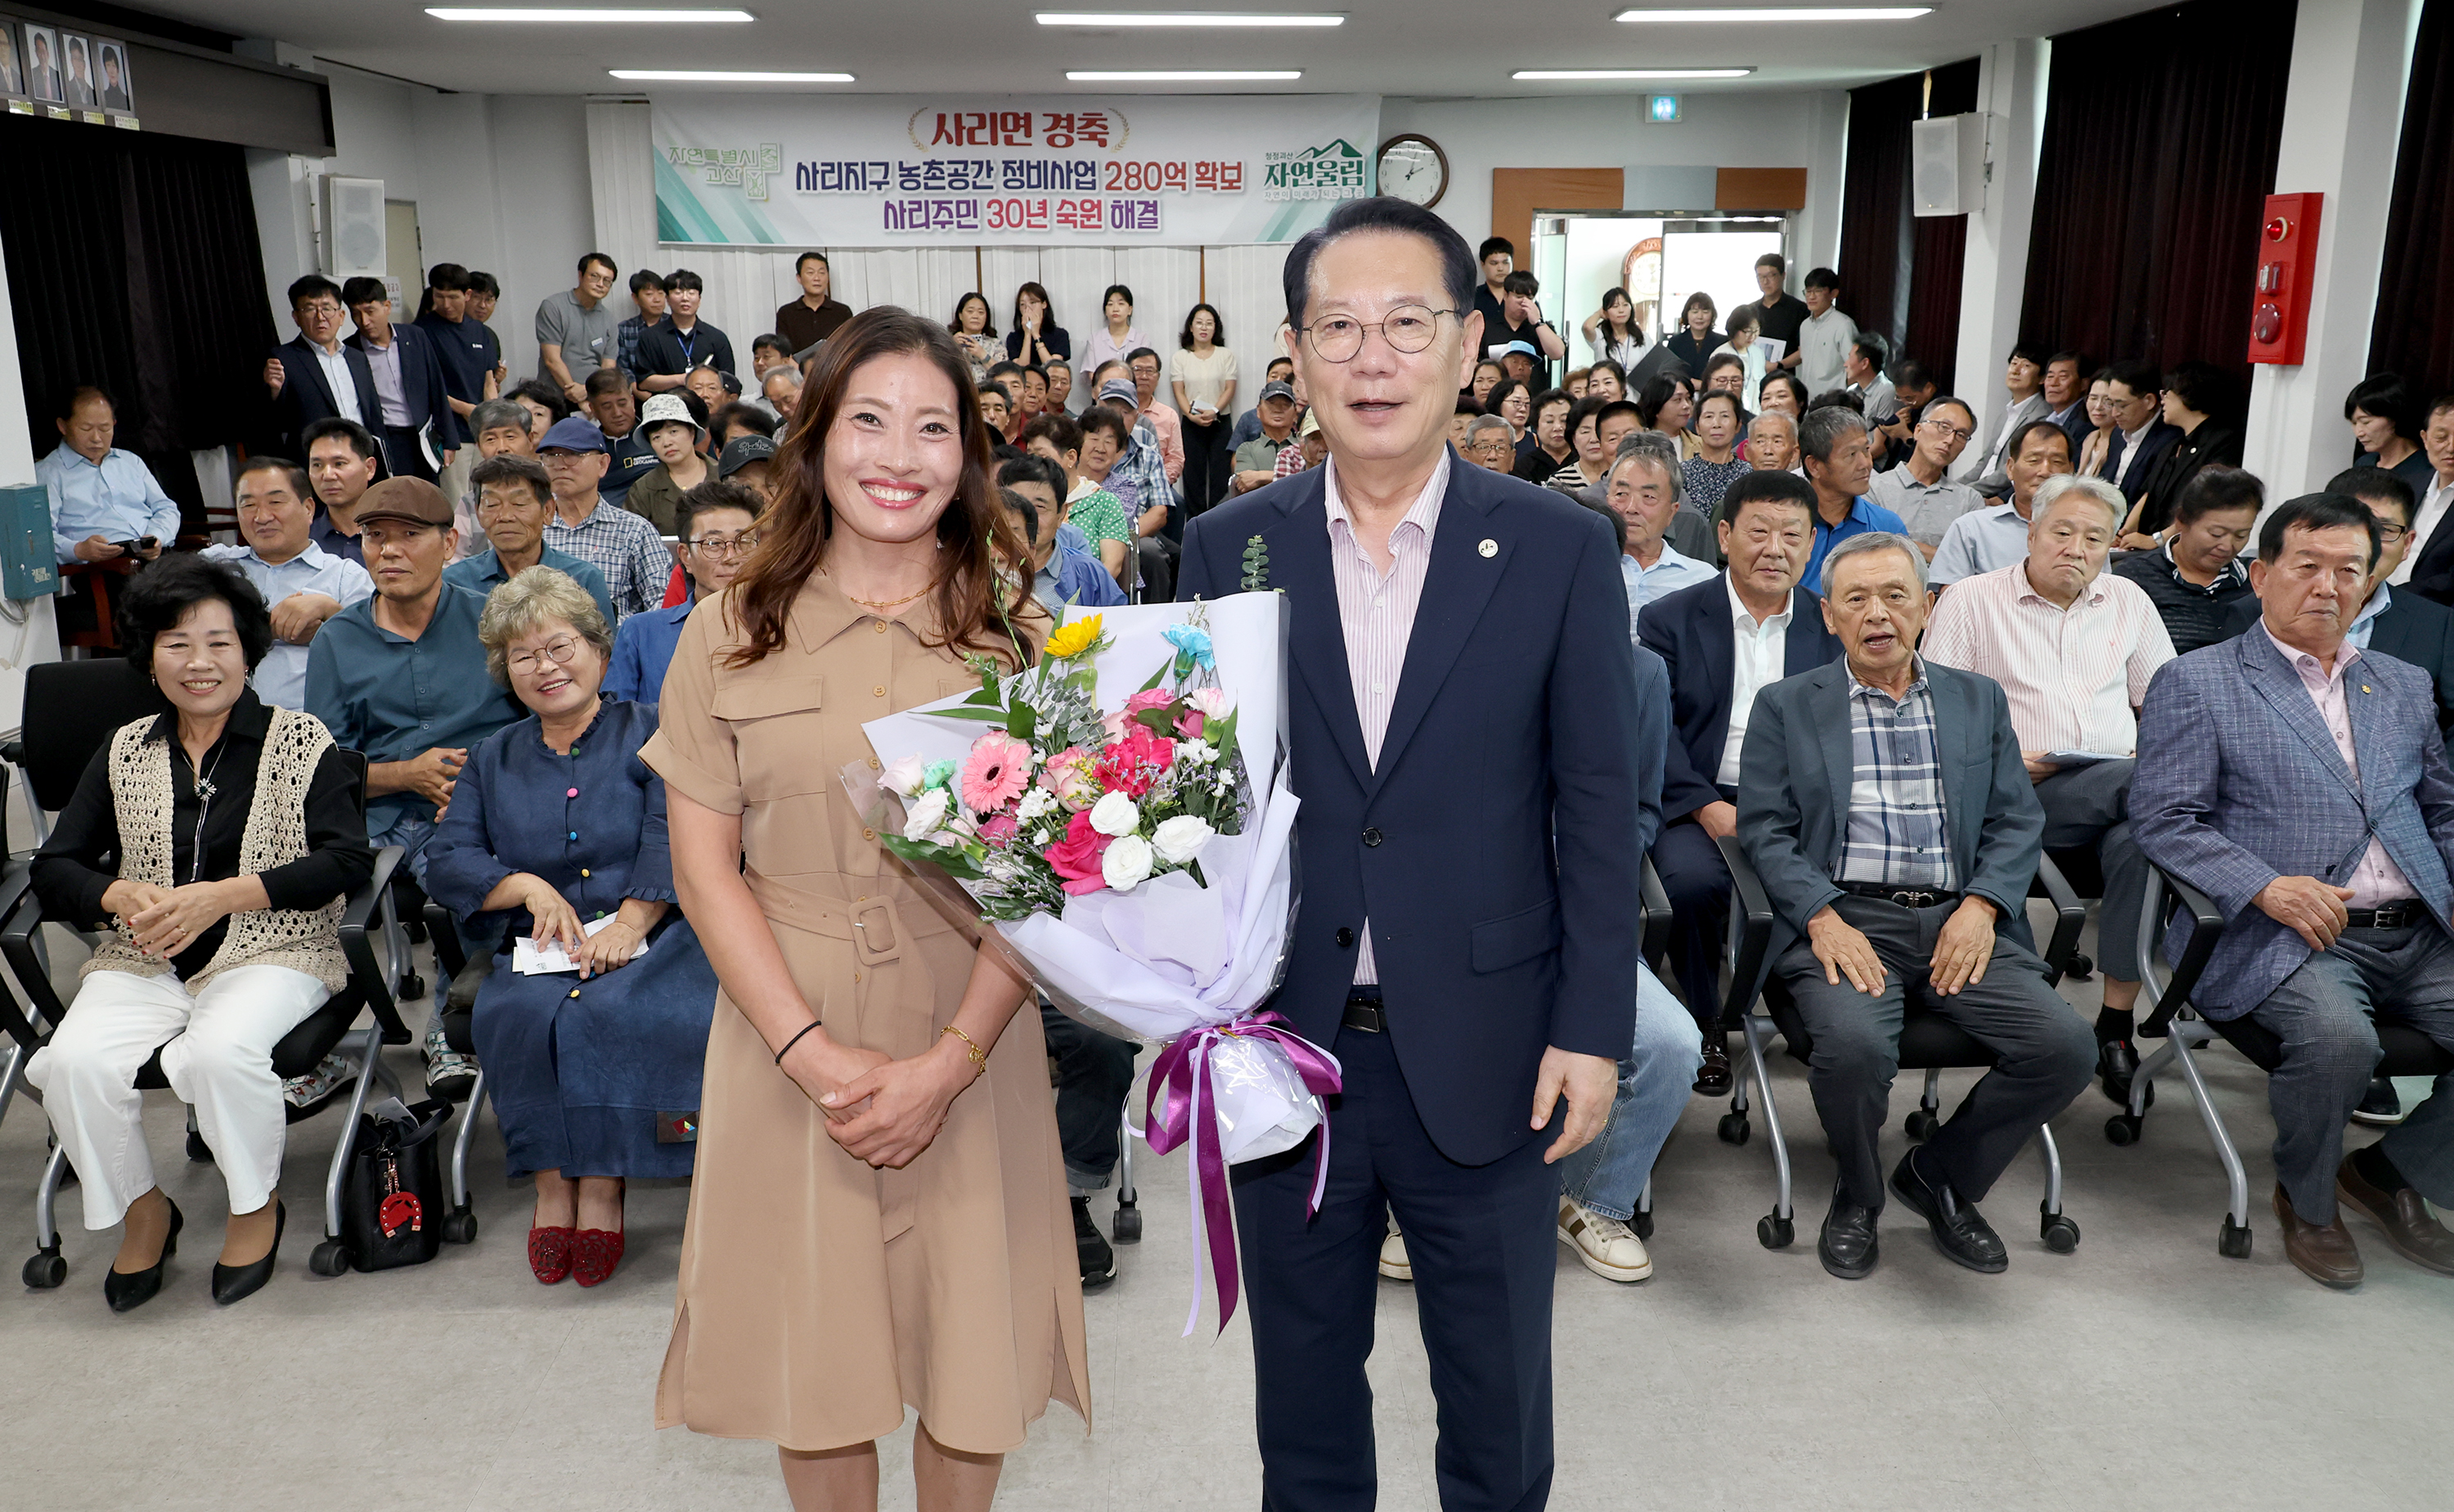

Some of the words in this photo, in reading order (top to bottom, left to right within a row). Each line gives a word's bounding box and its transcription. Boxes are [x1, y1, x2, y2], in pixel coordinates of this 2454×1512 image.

[931, 112, 1032, 146] 사리면
[1043, 112, 1109, 147] 경축
[669, 147, 756, 164] 자연특별시
[1265, 152, 1293, 160] 청정괴산
[1430, 157, 1436, 166] 2
[706, 168, 739, 183] 괴산
[796, 161, 890, 191] 사리지구
[898, 159, 994, 191] 농촌공간
[1002, 159, 1096, 191] 정비사업
[1105, 161, 1186, 191] 280억
[1195, 160, 1242, 191] 확보
[1264, 159, 1363, 187] 자연울림
[1433, 172, 1438, 180] 3
[883, 199, 978, 229] 사리주민
[987, 198, 1048, 229] 30년
[1056, 199, 1102, 229] 숙원
[1111, 200, 1158, 229] 해결
